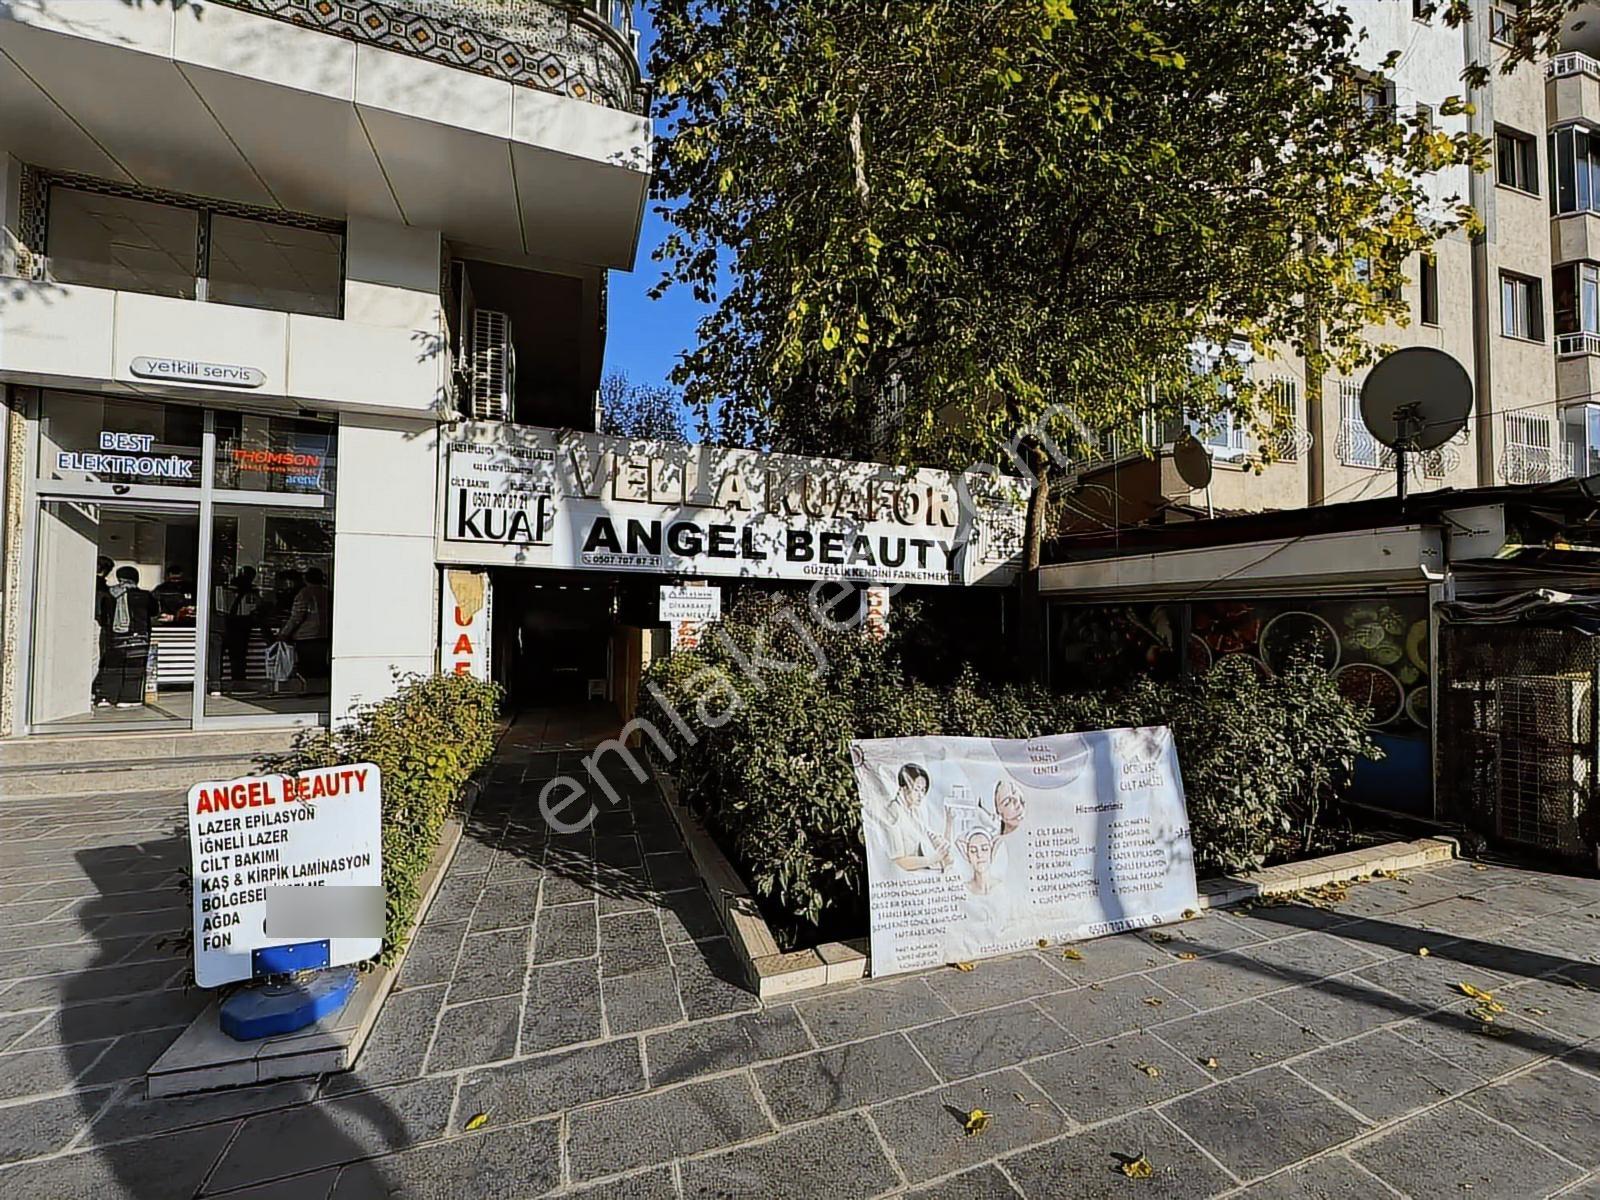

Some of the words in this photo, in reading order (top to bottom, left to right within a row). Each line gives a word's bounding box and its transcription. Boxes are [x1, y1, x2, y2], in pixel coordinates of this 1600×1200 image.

[147, 359, 198, 375] yetkili
[203, 366, 250, 381] servis
[100, 432, 154, 451] BEST
[56, 452, 193, 478] ELEKTRONİK
[232, 449, 320, 467] THOMSON
[285, 475, 318, 485] arena
[582, 516, 767, 560] ANGEL
[786, 530, 963, 571] BEAUTY
[593, 556, 614, 564] 0507
[197, 781, 275, 815] ANGEL
[283, 769, 368, 803] BEAUTY
[198, 817, 241, 836] LAZER
[245, 807, 315, 828] EPİLASYON
[200, 832, 244, 854] İĞNELİ
[248, 829, 288, 847] LAZER
[201, 855, 230, 873] CİLT
[234, 849, 279, 867] BAKIMI
[201, 876, 229, 893] KAŞ
[234, 873, 242, 886] &
[248, 864, 289, 884] KİRPİK
[292, 854, 370, 878] LAMİNASYON
[202, 912, 240, 932] AĞDA
[203, 932, 232, 951] FÖN
